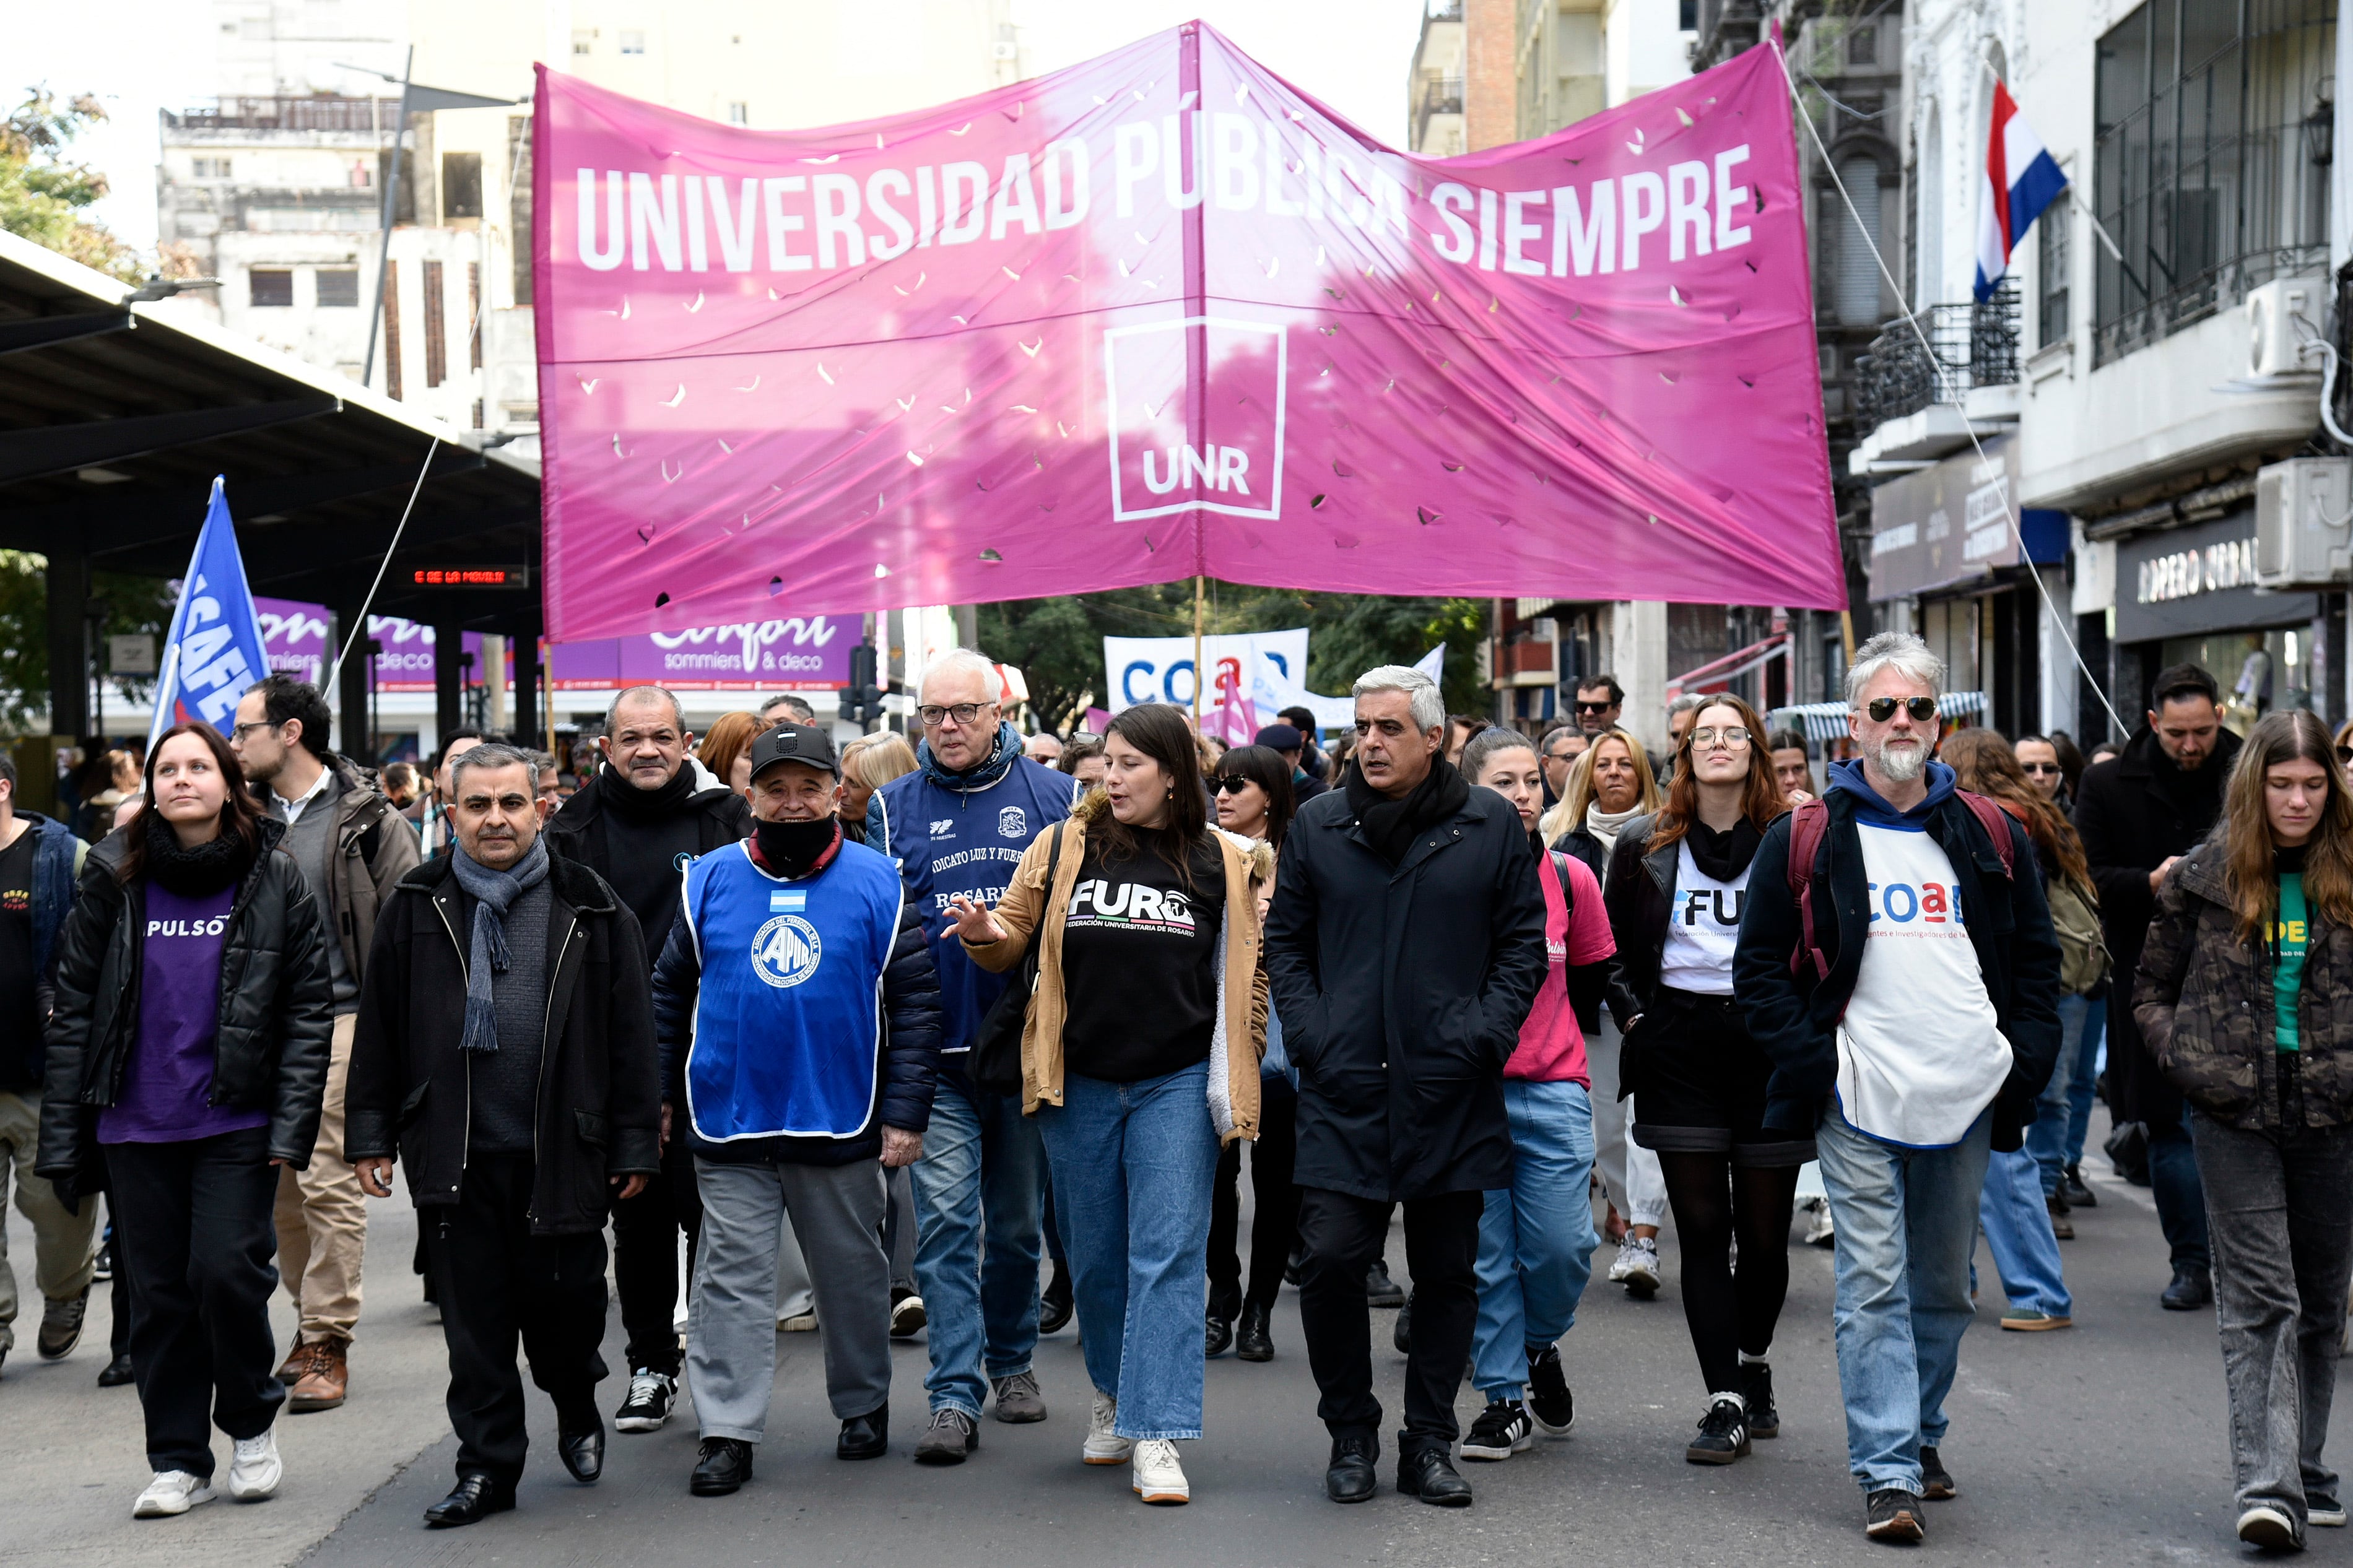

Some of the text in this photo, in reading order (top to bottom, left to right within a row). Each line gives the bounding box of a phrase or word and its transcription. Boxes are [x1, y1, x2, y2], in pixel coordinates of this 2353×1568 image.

[576, 90, 1752, 277] UNIVERSIDAD PÚBLICA SIEMPRE
[1142, 444, 1251, 495] UNR
[664, 651, 823, 671] sommiers & deco
[970, 847, 986, 861] LUZ
[989, 847, 996, 860] Y
[143, 919, 224, 937] PULSO
[786, 917, 812, 934] PERSONAL
[1065, 919, 1103, 928] FEDERACIÓN
[1104, 920, 1156, 931] UNIVERSITARIA
[1167, 926, 1194, 937] ROSARIO
[1895, 930, 1947, 938] Investigadores
[809, 933, 816, 941] DE
[812, 940, 819, 949] LA
[761, 926, 810, 974] APUR
[753, 952, 819, 985] UNIVERSIDAD NACIONAL DE ROSARIO
